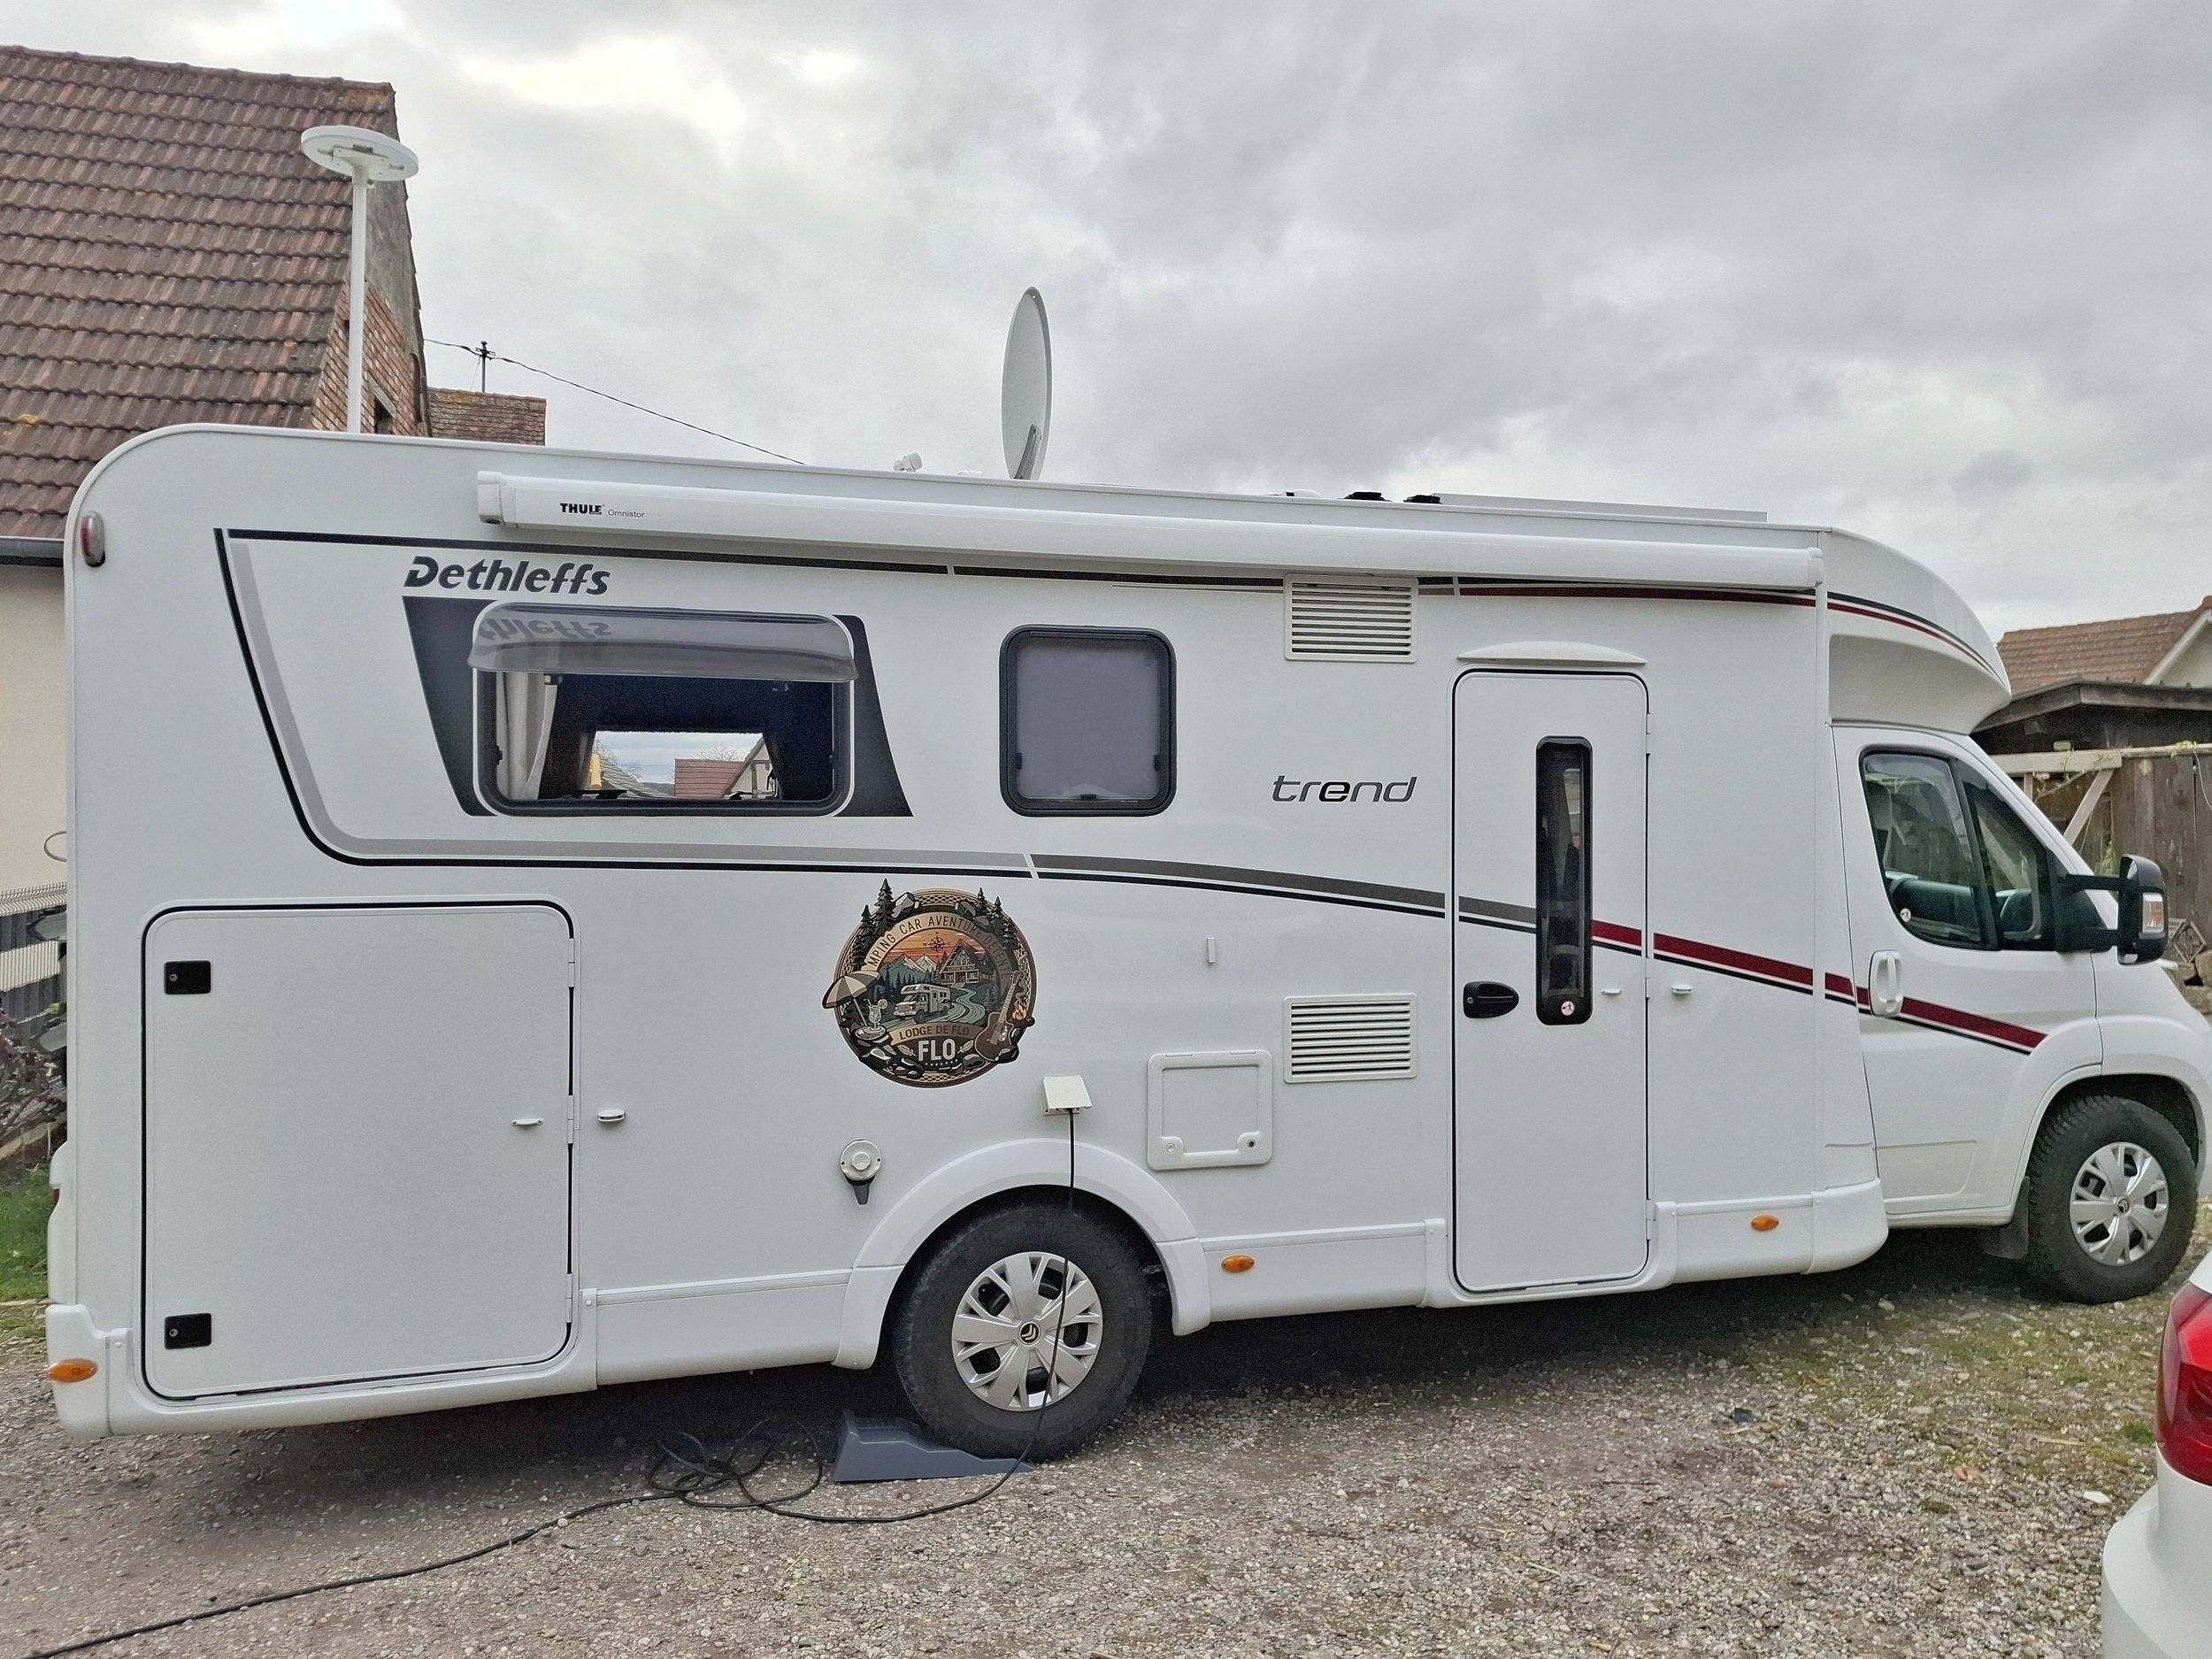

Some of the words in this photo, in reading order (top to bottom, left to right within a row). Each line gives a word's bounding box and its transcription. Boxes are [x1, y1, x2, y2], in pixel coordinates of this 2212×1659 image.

[559, 503, 603, 516] THULE
[607, 509, 646, 518] Omnistor
[403, 555, 611, 595] Dethleffs
[1272, 775, 1417, 802] trend
[899, 918, 923, 934] CAR
[899, 1025, 933, 1041] LODGE
[935, 1025, 949, 1034] DE
[951, 1025, 971, 1036] FLO
[918, 1038, 956, 1062] FLO
